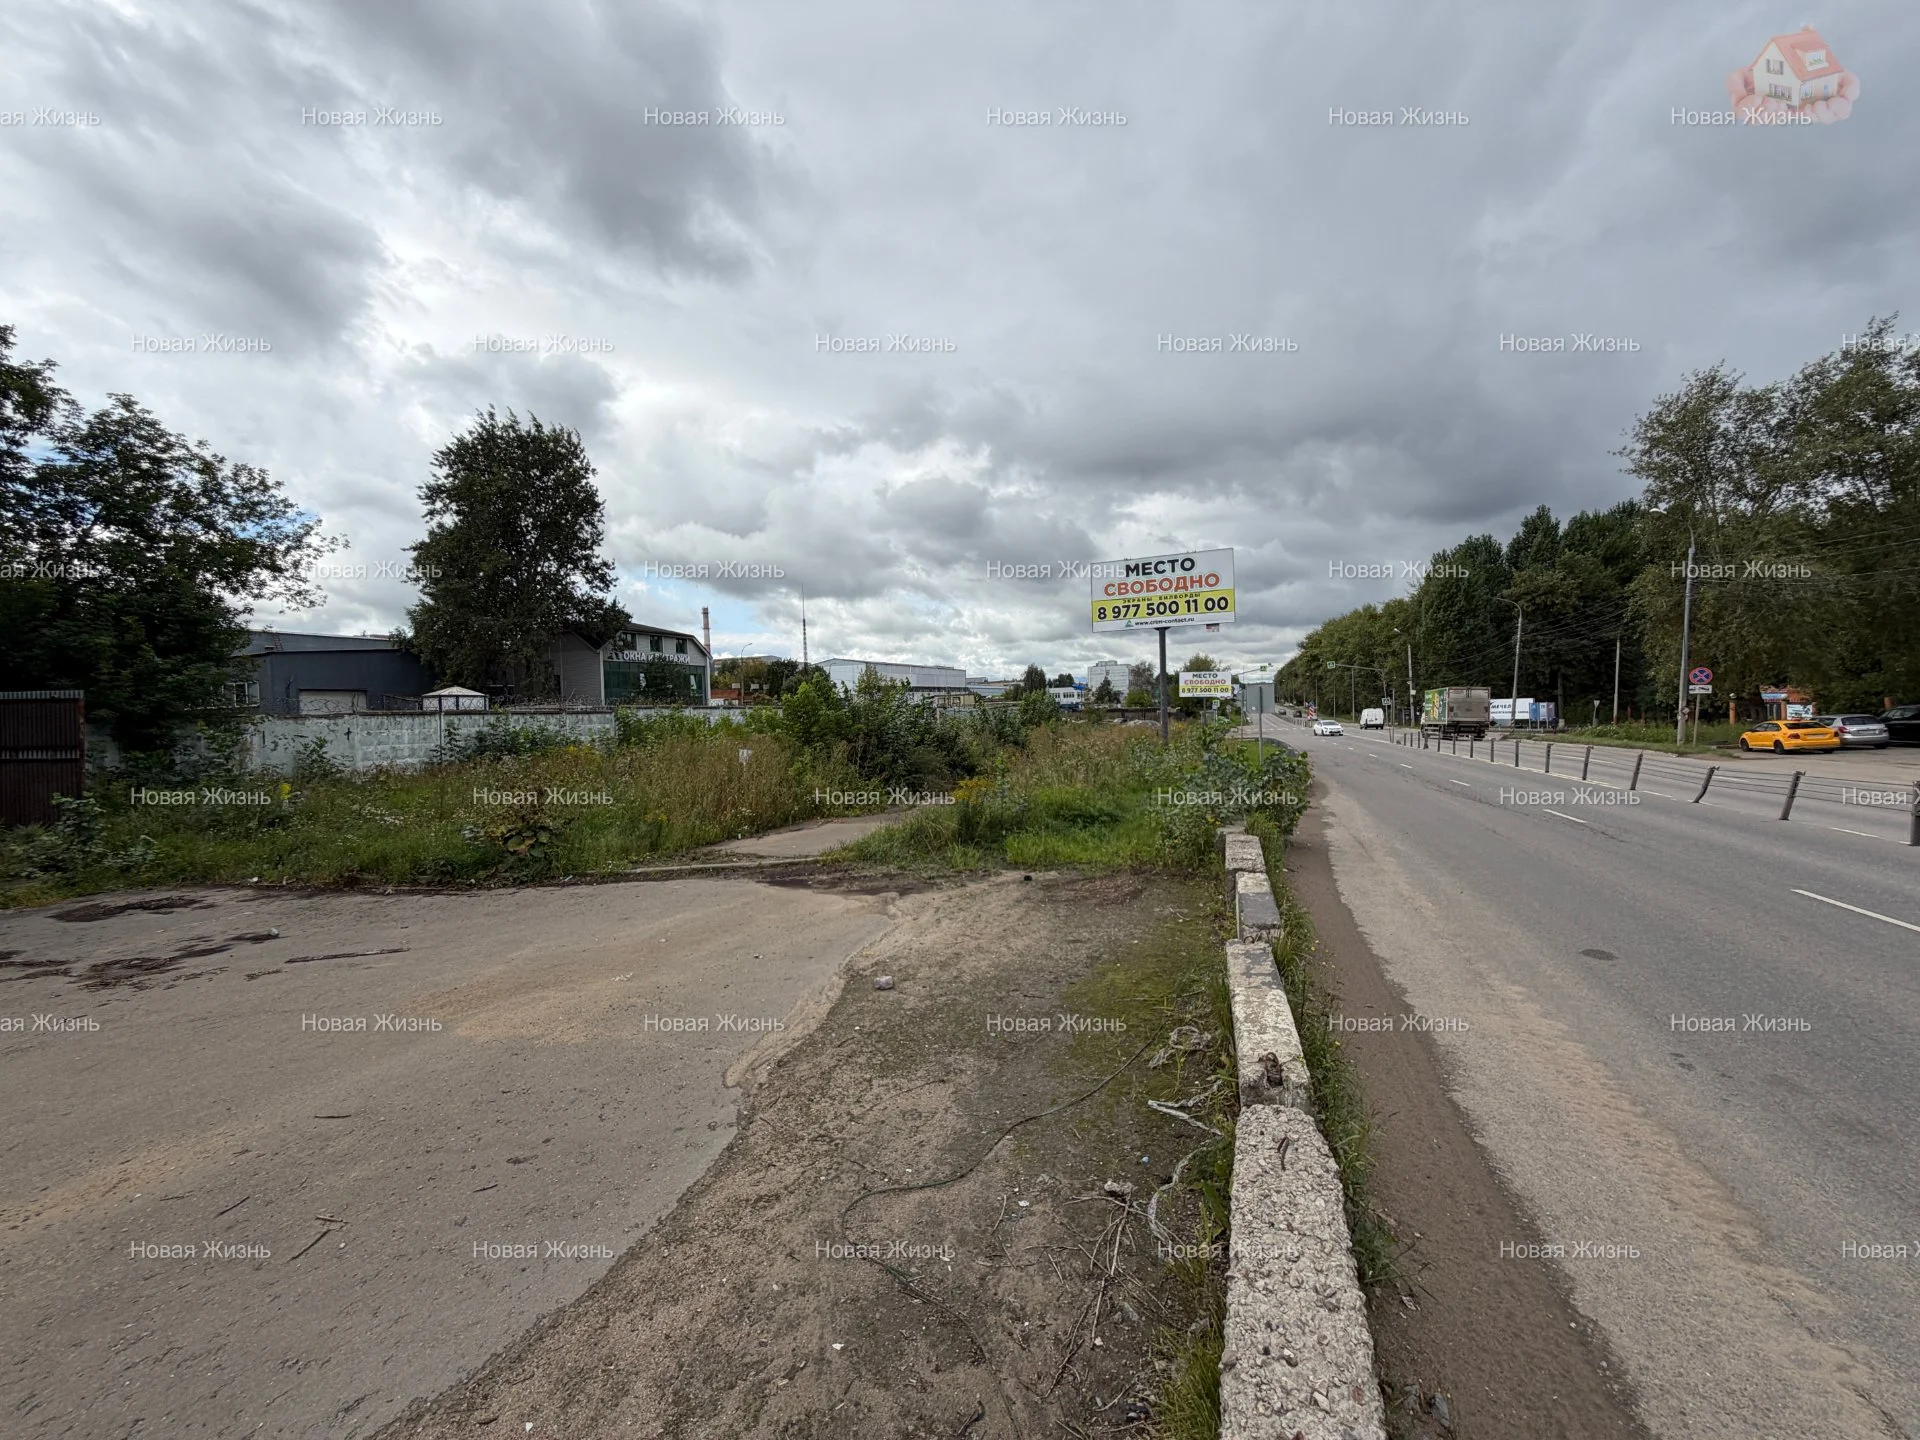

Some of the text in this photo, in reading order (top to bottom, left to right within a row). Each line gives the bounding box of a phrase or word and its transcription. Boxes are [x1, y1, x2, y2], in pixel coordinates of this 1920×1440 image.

[1125, 557, 1196, 577] МЕСТО
[1104, 573, 1221, 597] СВОБОДНО
[1158, 592, 1201, 601] БИЛБОРДЫ
[1097, 596, 1229, 620] 8 977 500 11 00
[623, 651, 646, 661] ОКНА
